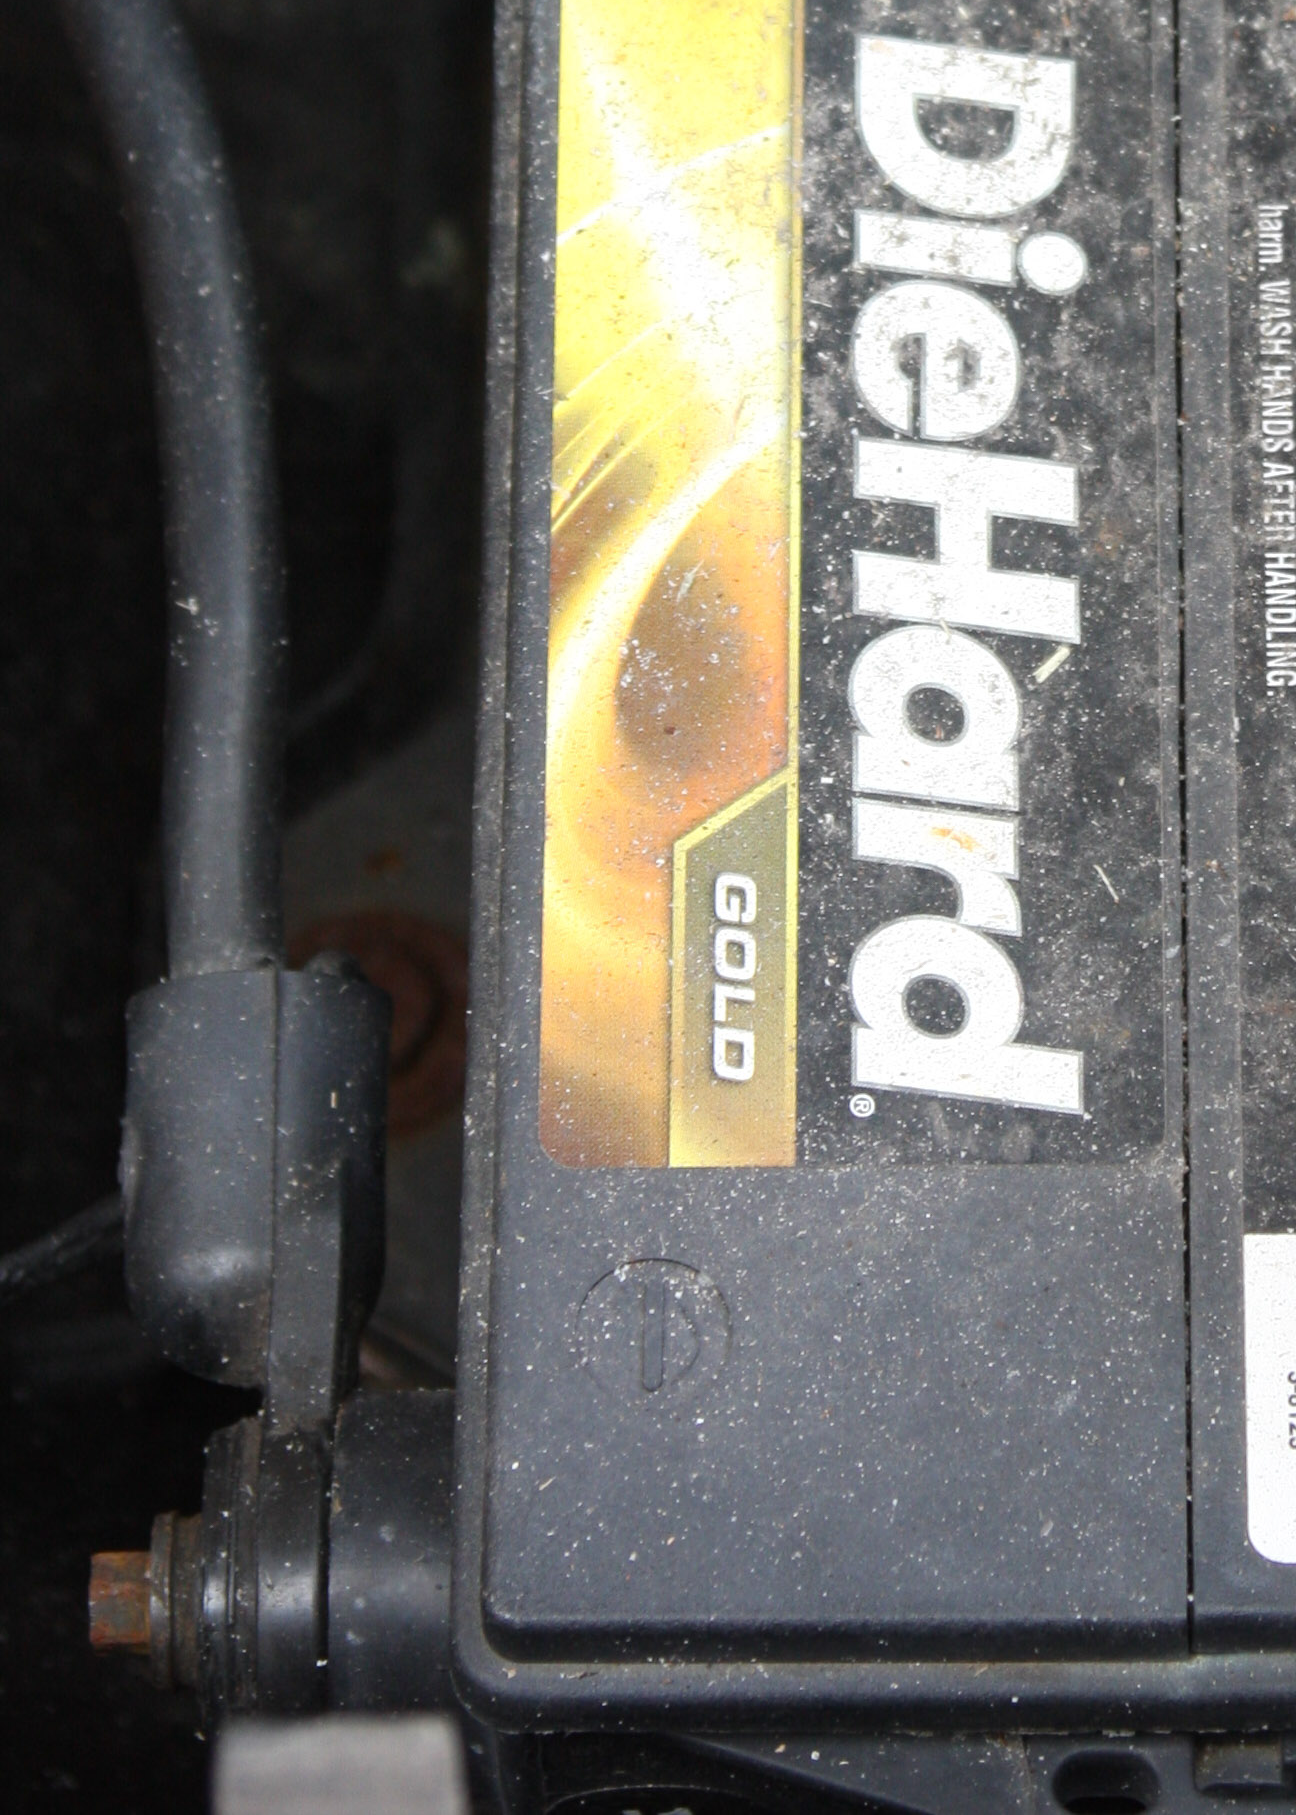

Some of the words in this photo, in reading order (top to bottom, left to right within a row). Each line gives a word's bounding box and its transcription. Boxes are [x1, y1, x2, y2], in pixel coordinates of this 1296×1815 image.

[1256, 204, 1289, 272] harm.
[1258, 278, 1293, 356] WASH
[1261, 365, 1295, 454] HANDS
[1263, 462, 1296, 542] AFTER
[712, 872, 758, 1082] GOLD
